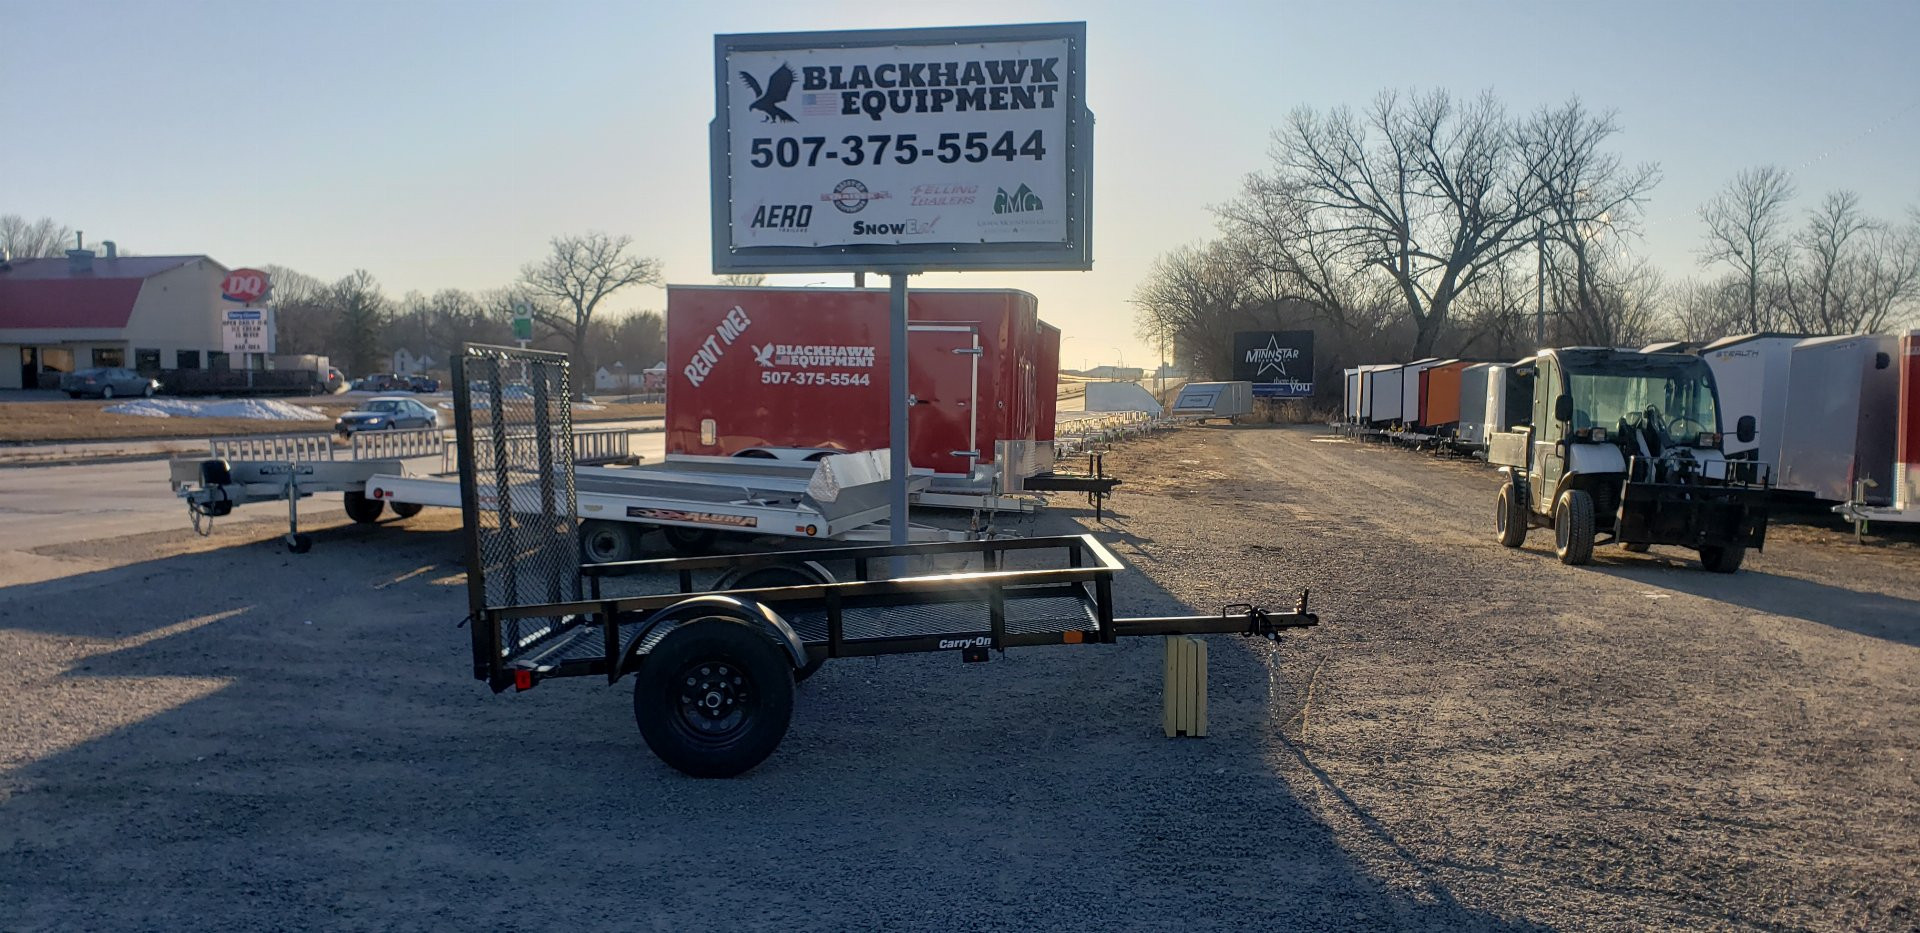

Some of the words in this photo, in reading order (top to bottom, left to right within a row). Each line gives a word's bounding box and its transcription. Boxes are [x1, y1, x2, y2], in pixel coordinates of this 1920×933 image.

[802, 57, 1059, 91] BLACKHAWK
[841, 85, 1058, 121] EQUIPMENT
[750, 129, 1047, 168] 507-375-5544
[911, 184, 978, 195] FELLING
[911, 195, 976, 206] TRAILERS
[992, 191, 1039, 215] GMG
[750, 204, 813, 228] AERO
[229, 276, 262, 296] DQ
[684, 334, 723, 388] RENT
[716, 305, 752, 345] ME!
[775, 345, 875, 357] BLACKHAWK
[1715, 350, 1759, 358] STEALTH
[790, 355, 875, 368] EQUIPMENT
[761, 371, 870, 386] 507-375-5544
[1290, 383, 1310, 394] you
[684, 512, 757, 527] ALUMA
[939, 636, 992, 649] Carry-On
